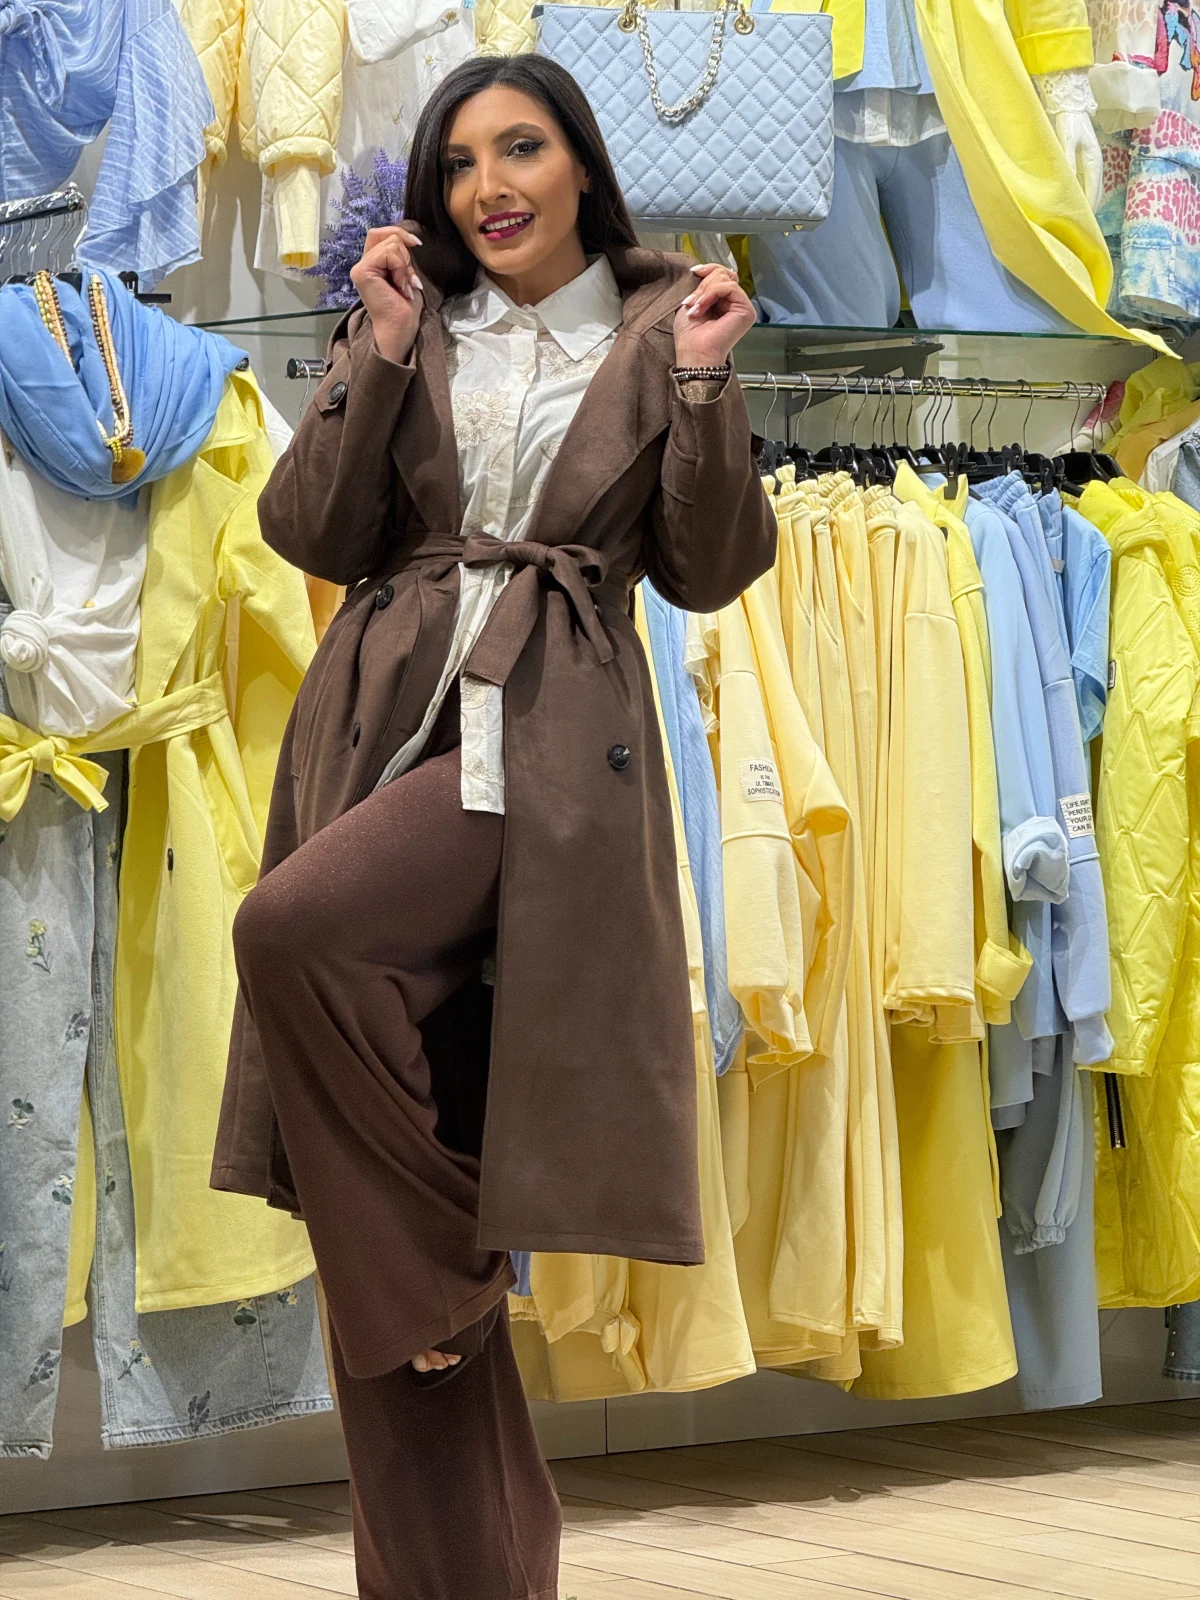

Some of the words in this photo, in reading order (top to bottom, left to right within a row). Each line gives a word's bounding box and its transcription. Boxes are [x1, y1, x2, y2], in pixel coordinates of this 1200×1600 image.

[750, 764, 773, 773] FASHION
[1066, 801, 1079, 809] LIFE
[1068, 807, 1091, 816] PERFEC
[1070, 816, 1087, 824] YOUR
